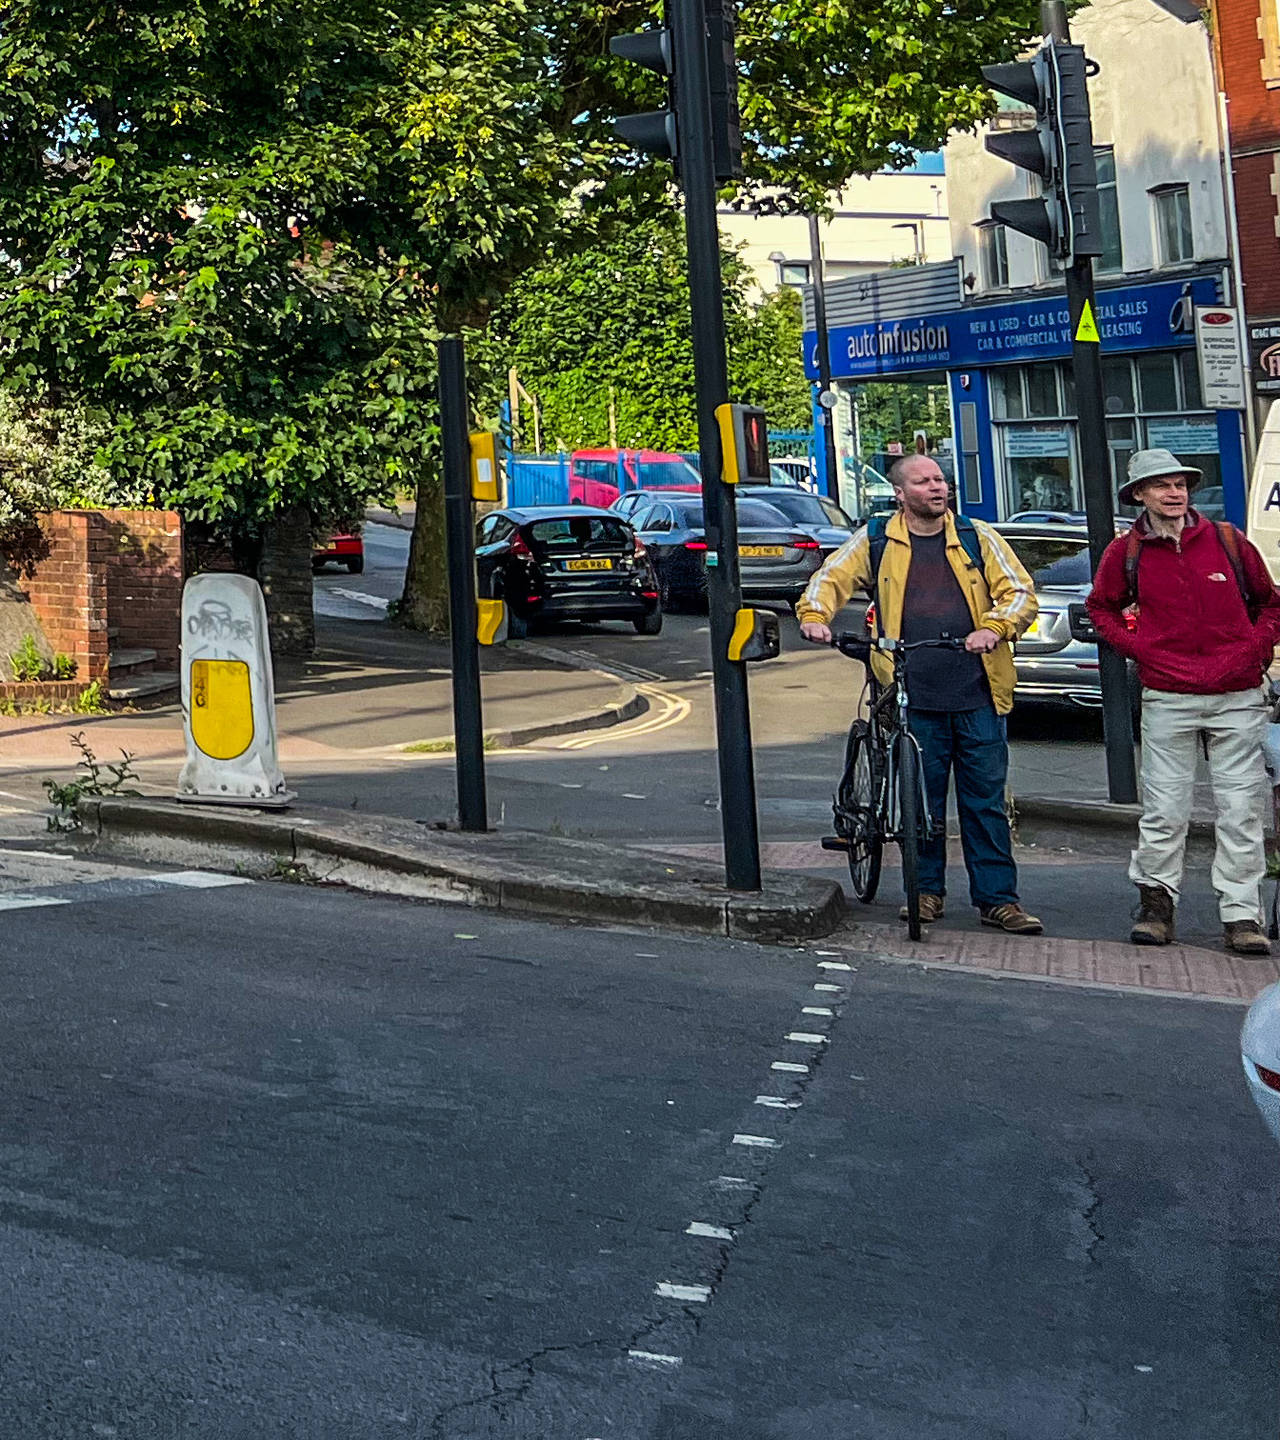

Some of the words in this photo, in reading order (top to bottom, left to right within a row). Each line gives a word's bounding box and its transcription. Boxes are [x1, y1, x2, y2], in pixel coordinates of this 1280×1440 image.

[998, 317, 1019, 330] USED
[1028, 314, 1046, 328] CAR
[1119, 300, 1148, 317] SALES
[977, 338, 993, 351] CAR
[1101, 321, 1142, 338] LEASING
